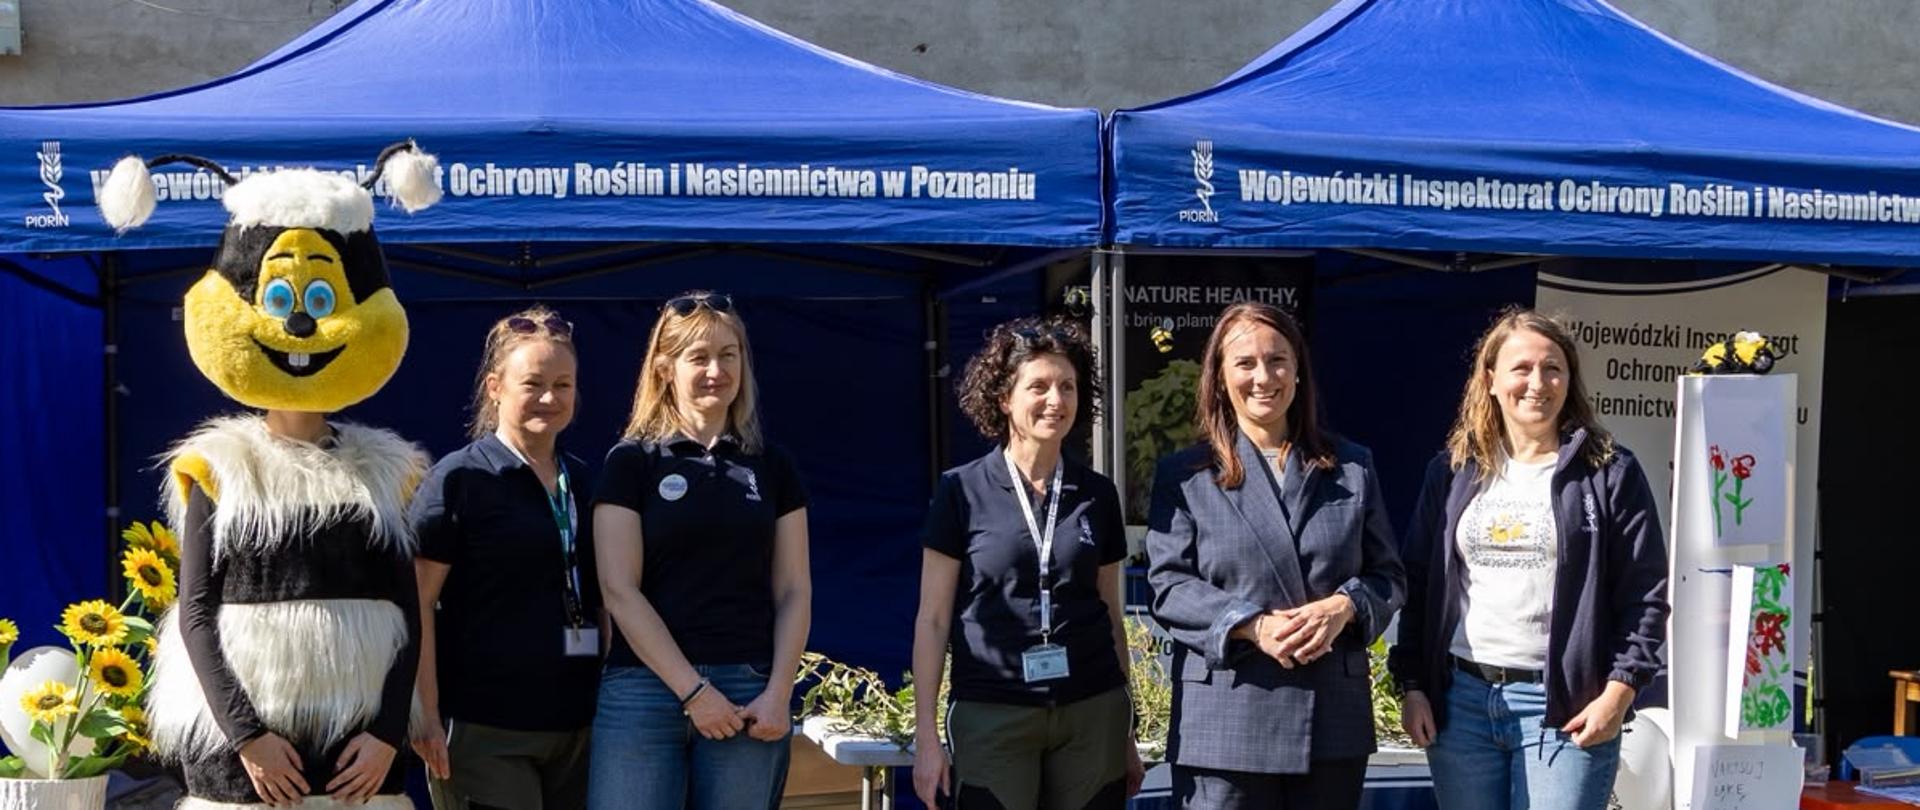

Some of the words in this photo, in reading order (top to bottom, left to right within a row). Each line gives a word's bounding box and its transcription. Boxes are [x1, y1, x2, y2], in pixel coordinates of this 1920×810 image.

[450, 162, 569, 198] Ochrony
[575, 161, 664, 195] Roślin
[670, 162, 680, 195] i
[686, 163, 876, 197] Nasiennictwa
[881, 170, 906, 197] w
[911, 165, 1036, 200] Poznaniu
[1239, 169, 1397, 206] Wojewódzki
[1403, 173, 1554, 211] Inspektorat
[1559, 179, 1665, 217] Ochrony
[1670, 183, 1749, 217] Roślin
[1754, 187, 1763, 217] i
[1768, 187, 1920, 223] Nasiennictw
[25, 214, 70, 228] PIORIN
[1180, 210, 1219, 223] PIORIN
[1123, 286, 1201, 304] NATURE
[1205, 286, 1299, 308] HEALTHY,
[1133, 311, 1168, 328] brin
